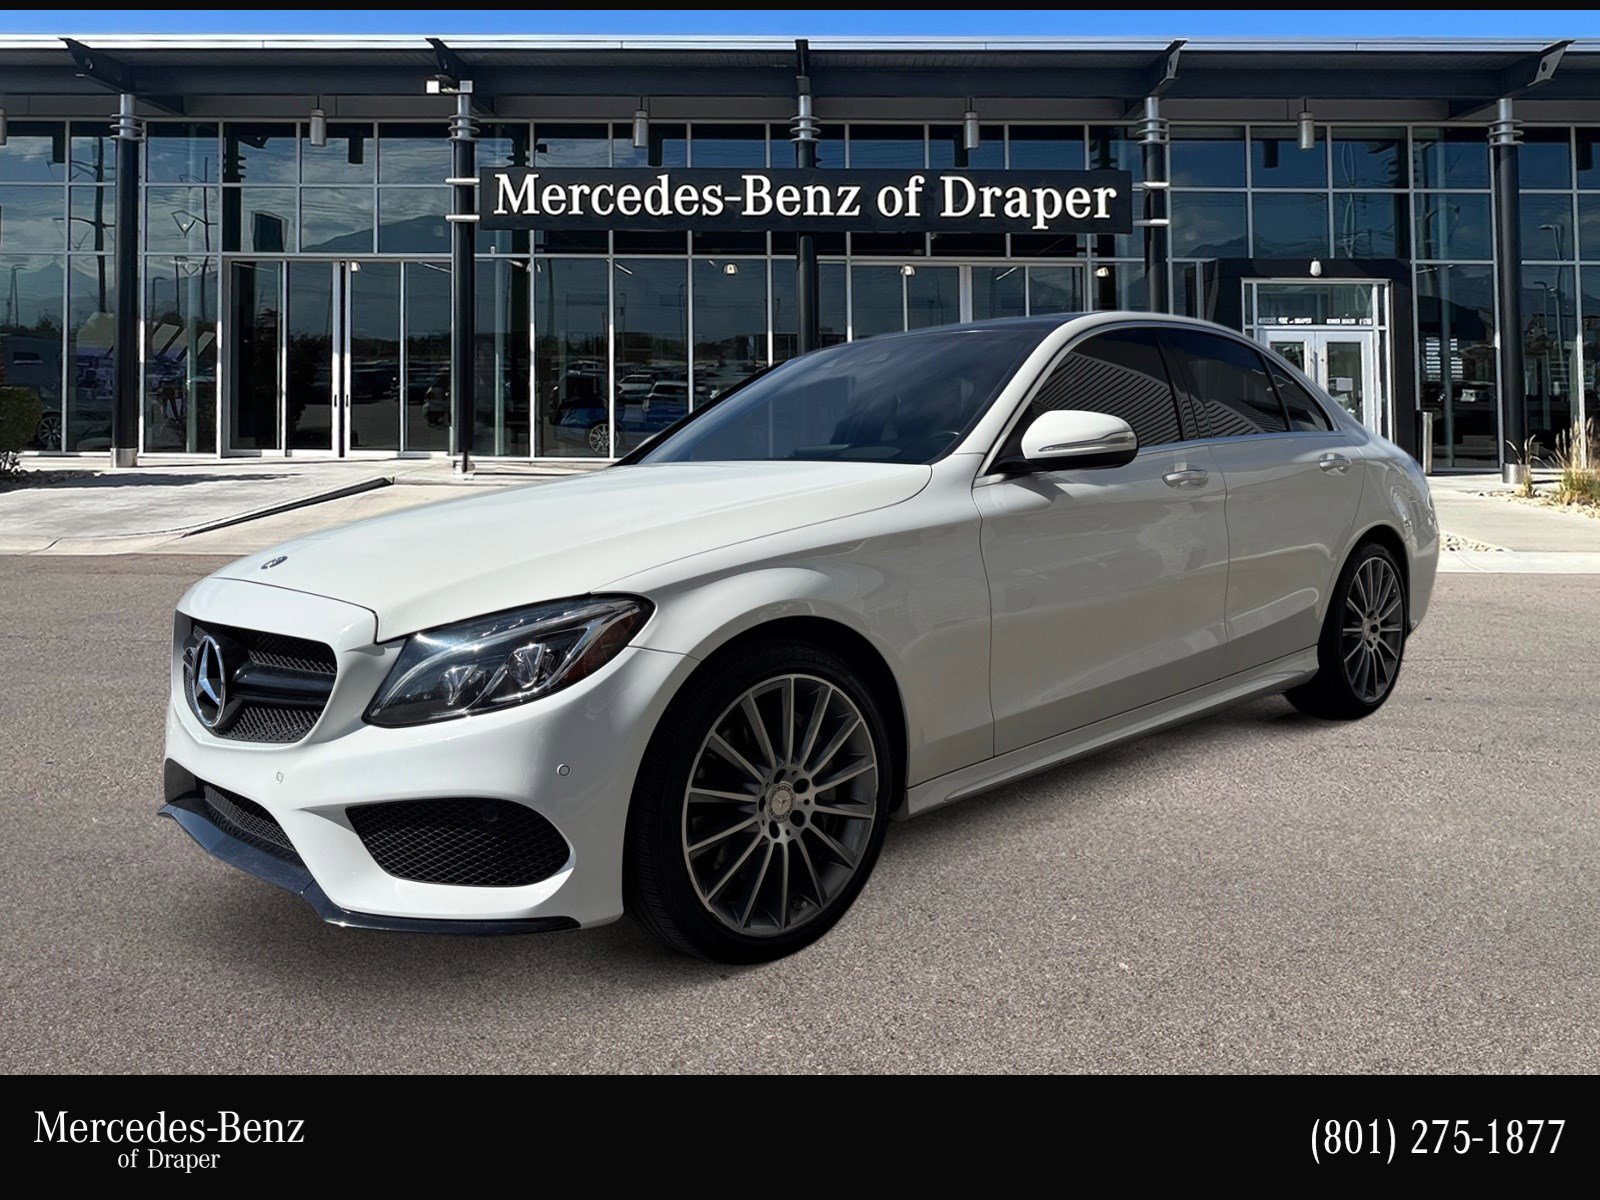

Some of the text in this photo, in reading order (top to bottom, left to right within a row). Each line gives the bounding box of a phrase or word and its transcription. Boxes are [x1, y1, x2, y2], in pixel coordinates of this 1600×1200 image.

[492, 173, 1117, 230] Mercedes-Benz of Draper
